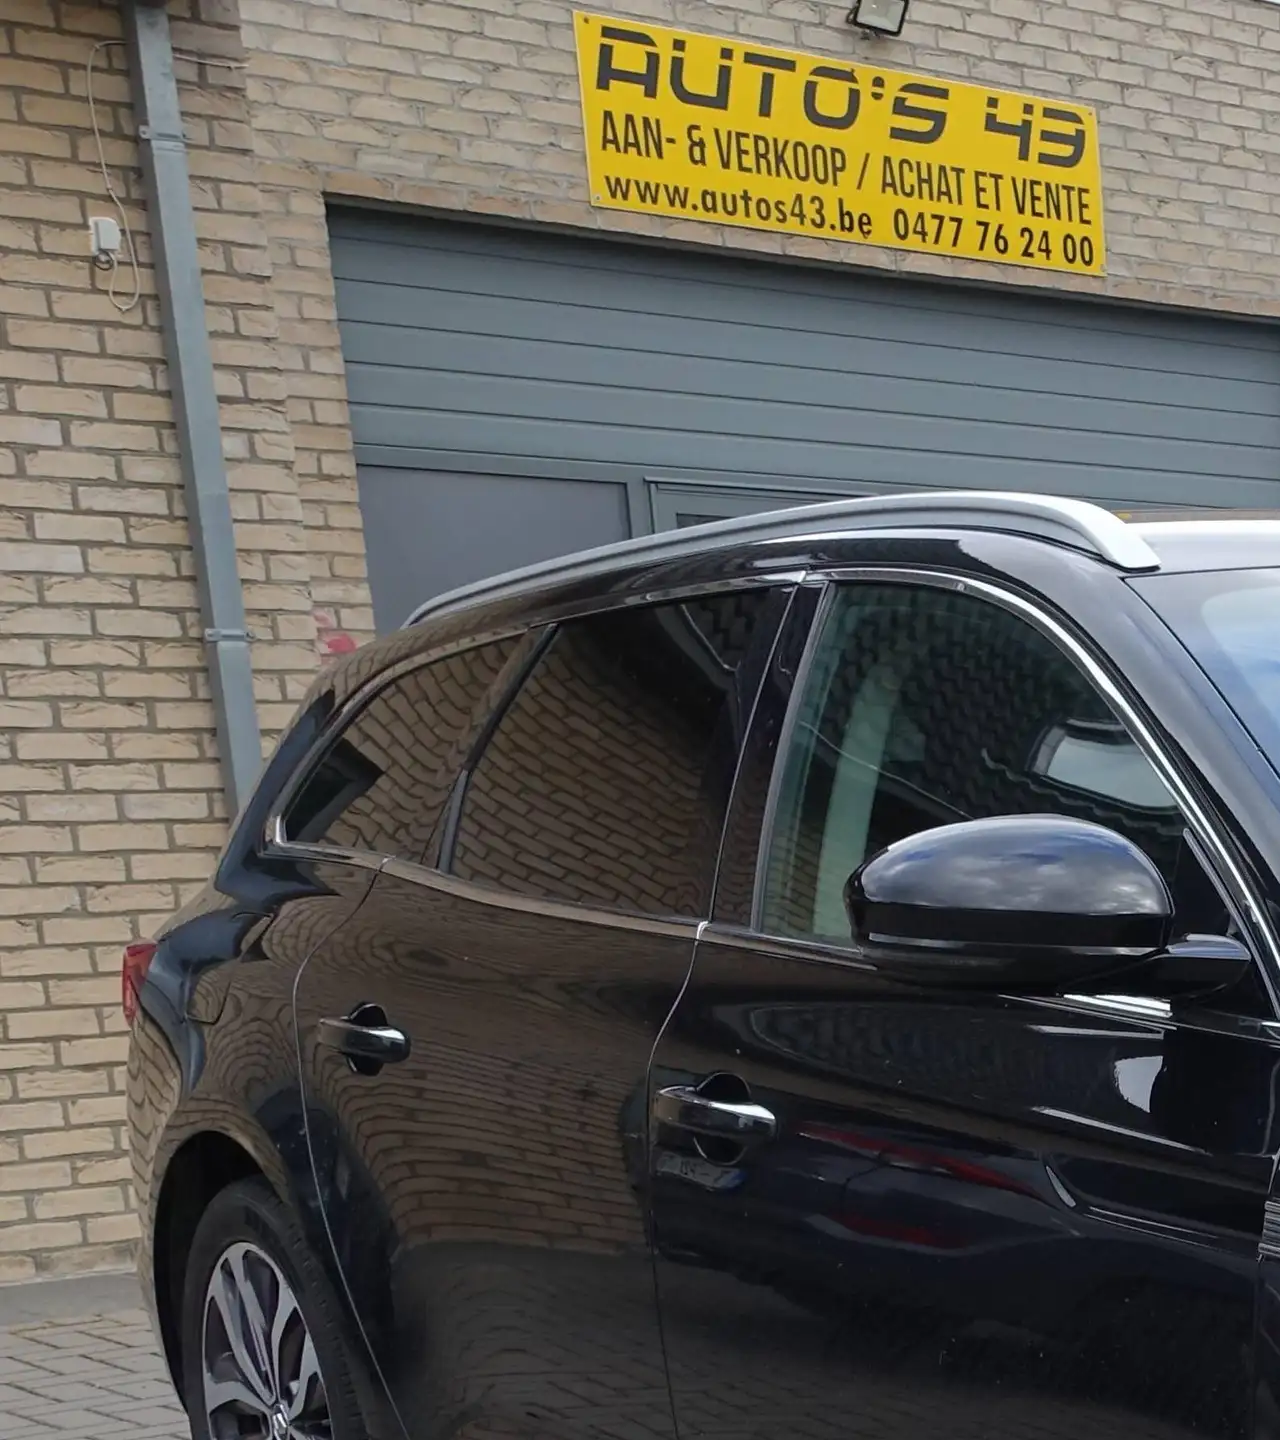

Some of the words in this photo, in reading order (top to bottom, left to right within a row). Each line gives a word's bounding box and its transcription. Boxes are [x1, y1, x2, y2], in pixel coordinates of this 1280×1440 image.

[596, 25, 949, 145] AUTO'S
[984, 96, 1086, 168] 43
[602, 110, 677, 161] AAN-
[687, 124, 707, 167] &
[715, 130, 847, 188] VERKOOP
[881, 157, 966, 207] ACHAT
[975, 171, 1004, 211] ET
[1011, 177, 1092, 226] VENTE
[605, 175, 873, 240] www.autos43.be
[893, 207, 962, 250] 0477
[976, 221, 1009, 256] 76
[1020, 227, 1052, 263] 24
[1063, 233, 1094, 268] 00
